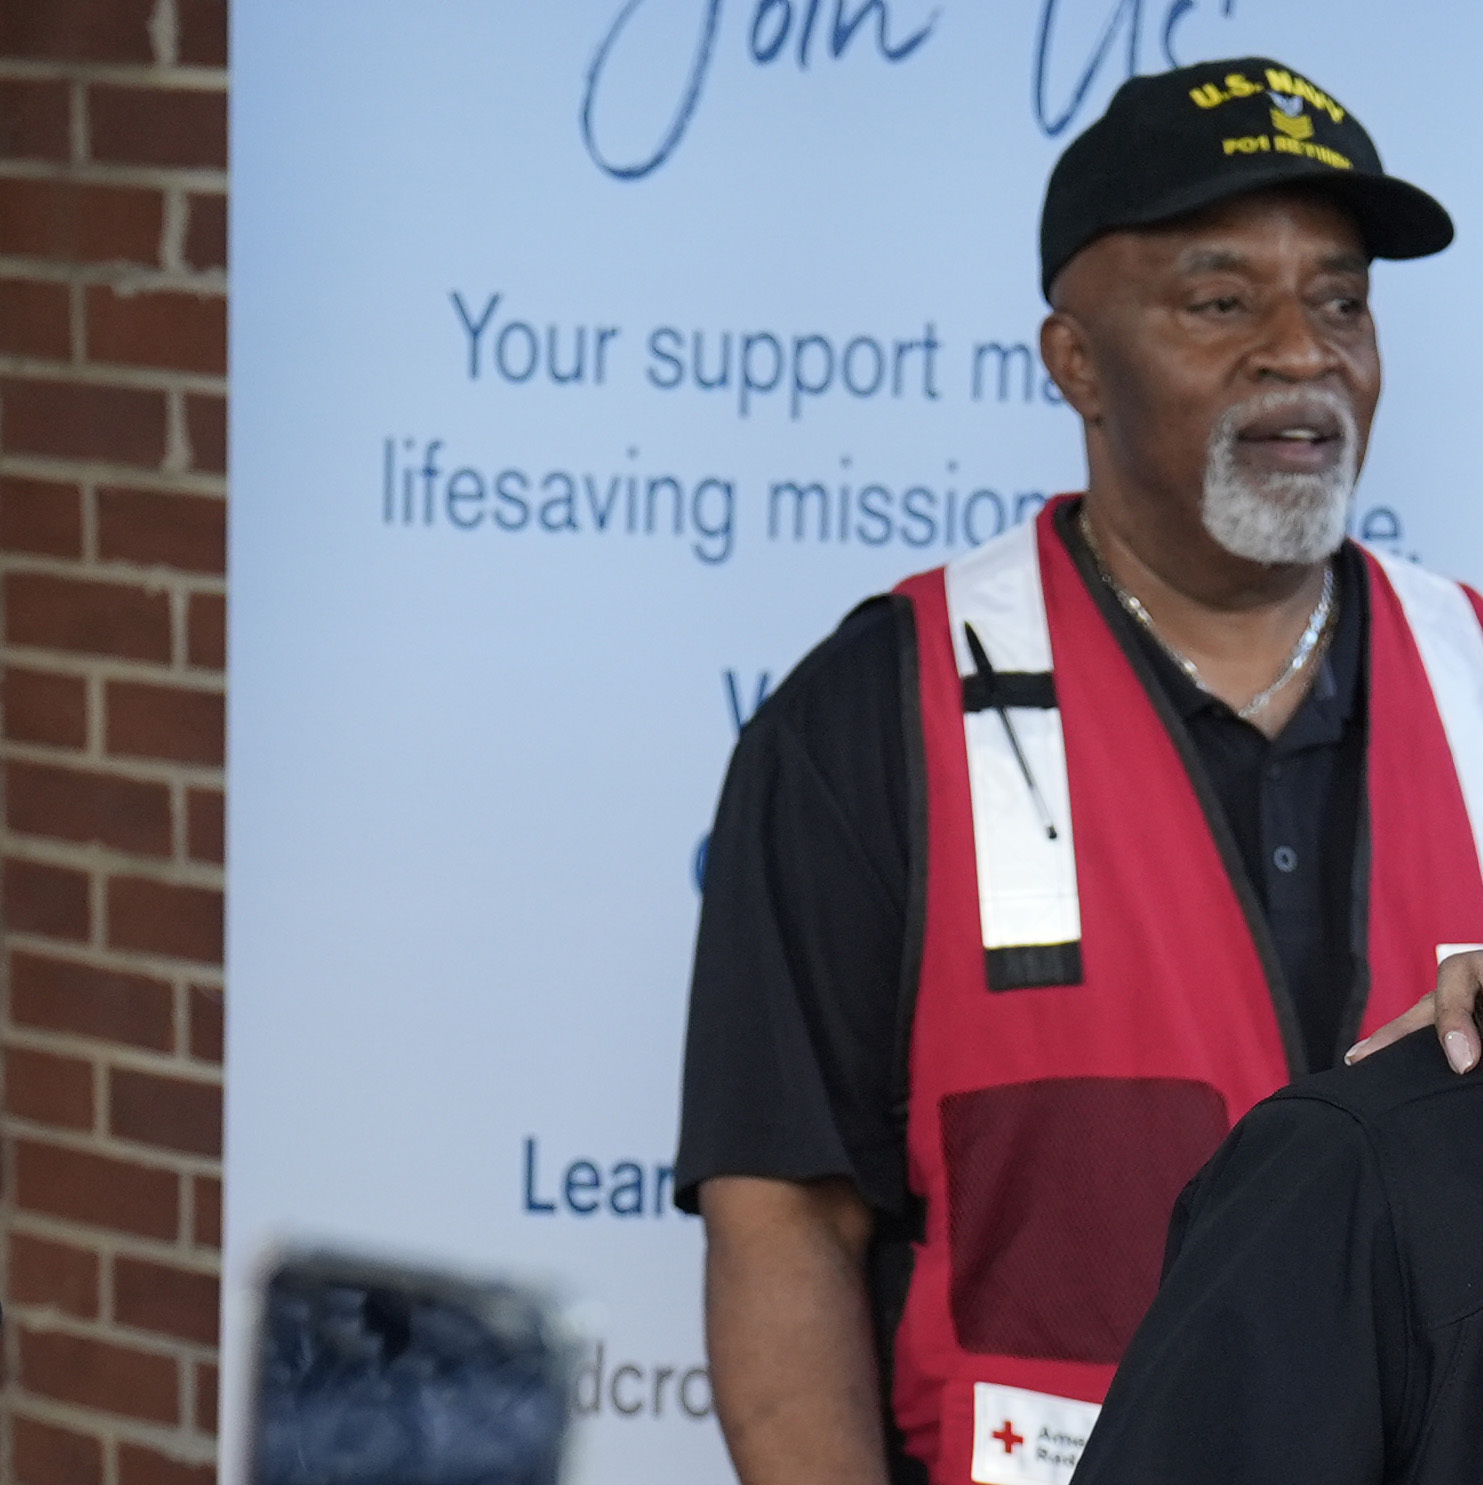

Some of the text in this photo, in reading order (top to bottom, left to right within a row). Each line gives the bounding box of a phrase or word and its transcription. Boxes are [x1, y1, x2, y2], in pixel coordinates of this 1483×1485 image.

[1264, 68, 1346, 124] NAVY
[449, 290, 622, 387] Your
[645, 318, 943, 422] support
[380, 436, 738, 566] lifesaving
